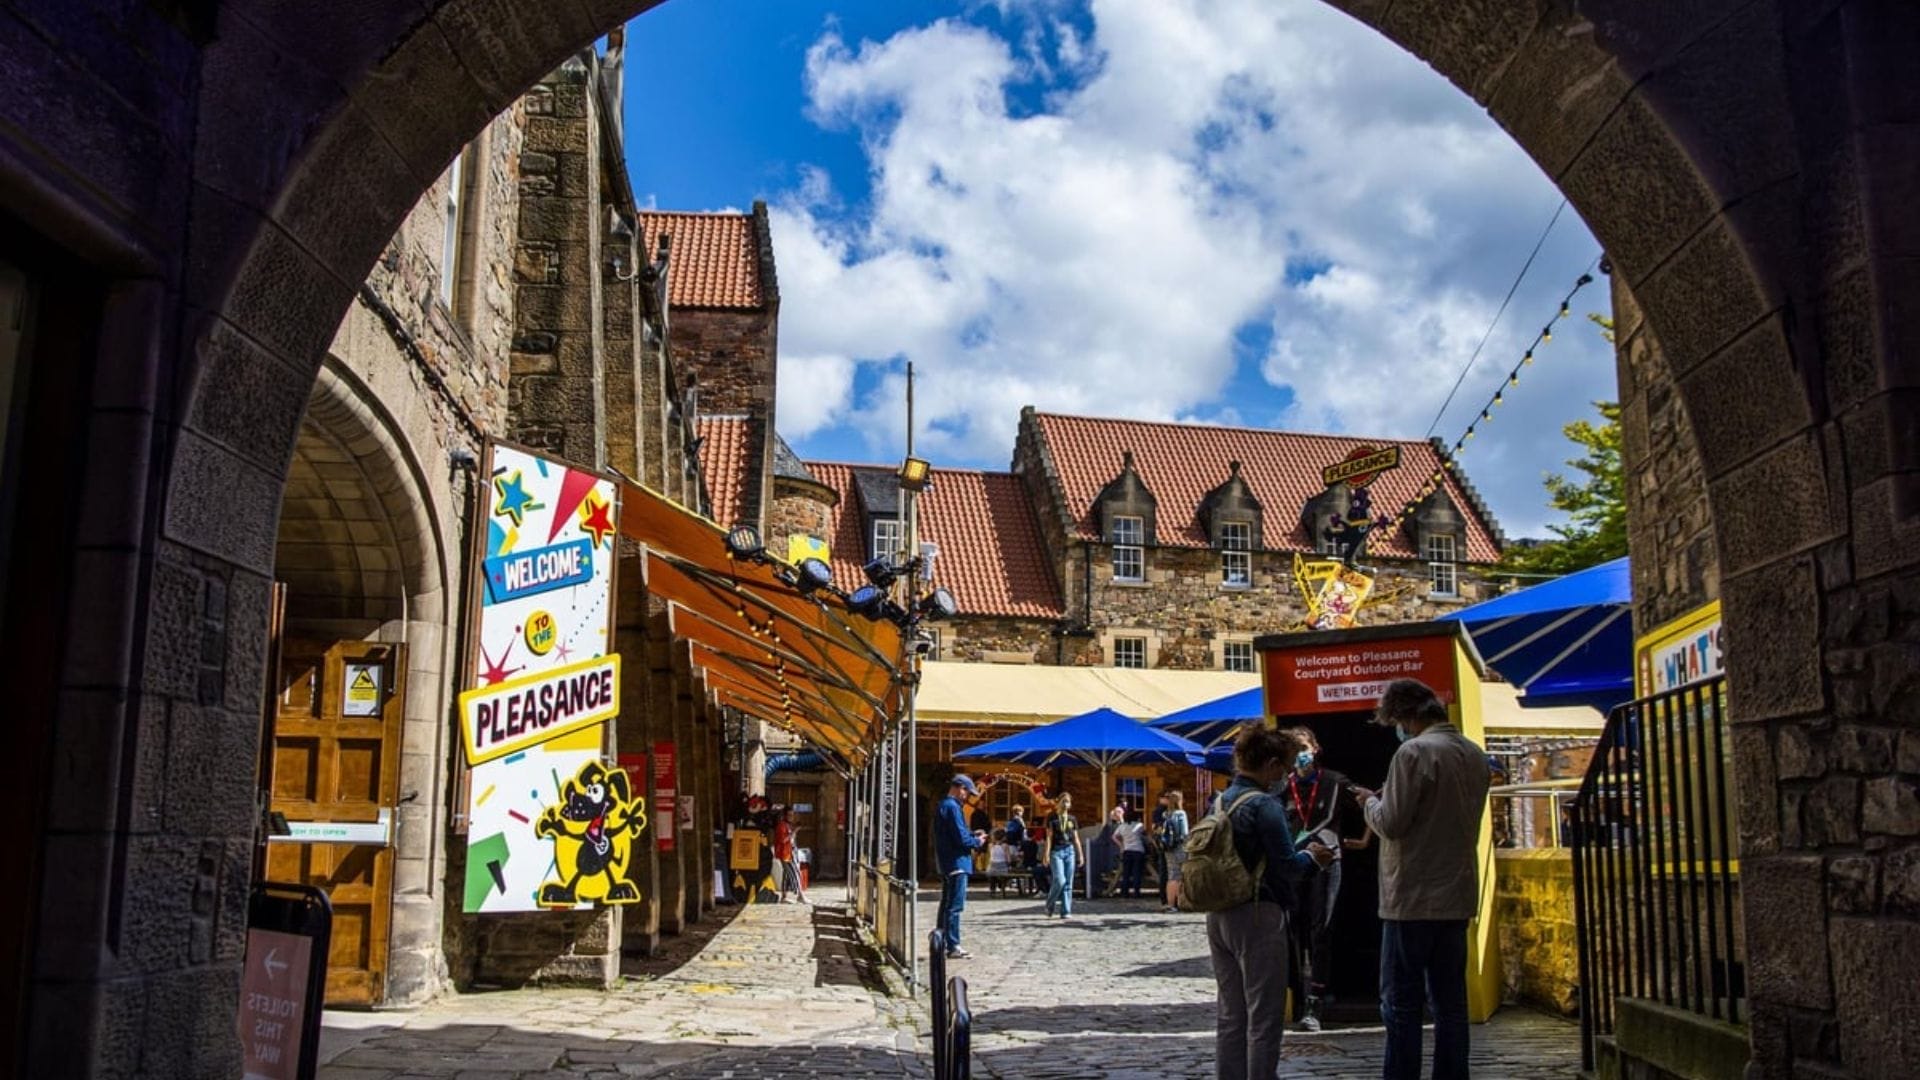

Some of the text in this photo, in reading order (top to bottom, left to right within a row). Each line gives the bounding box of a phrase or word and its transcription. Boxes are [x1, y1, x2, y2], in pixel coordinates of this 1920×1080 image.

[1329, 451, 1393, 481] PLEASANCE
[503, 546, 581, 592] WELCOME
[535, 614, 549, 631] TO
[532, 627, 552, 647] THE
[1296, 650, 1420, 667] Welcome to Pleasance
[1294, 661, 1424, 679] Courtyard Outdoor Bar
[1322, 685, 1385, 698] WE'RE OPE
[476, 669, 613, 748] PLEASANCE
